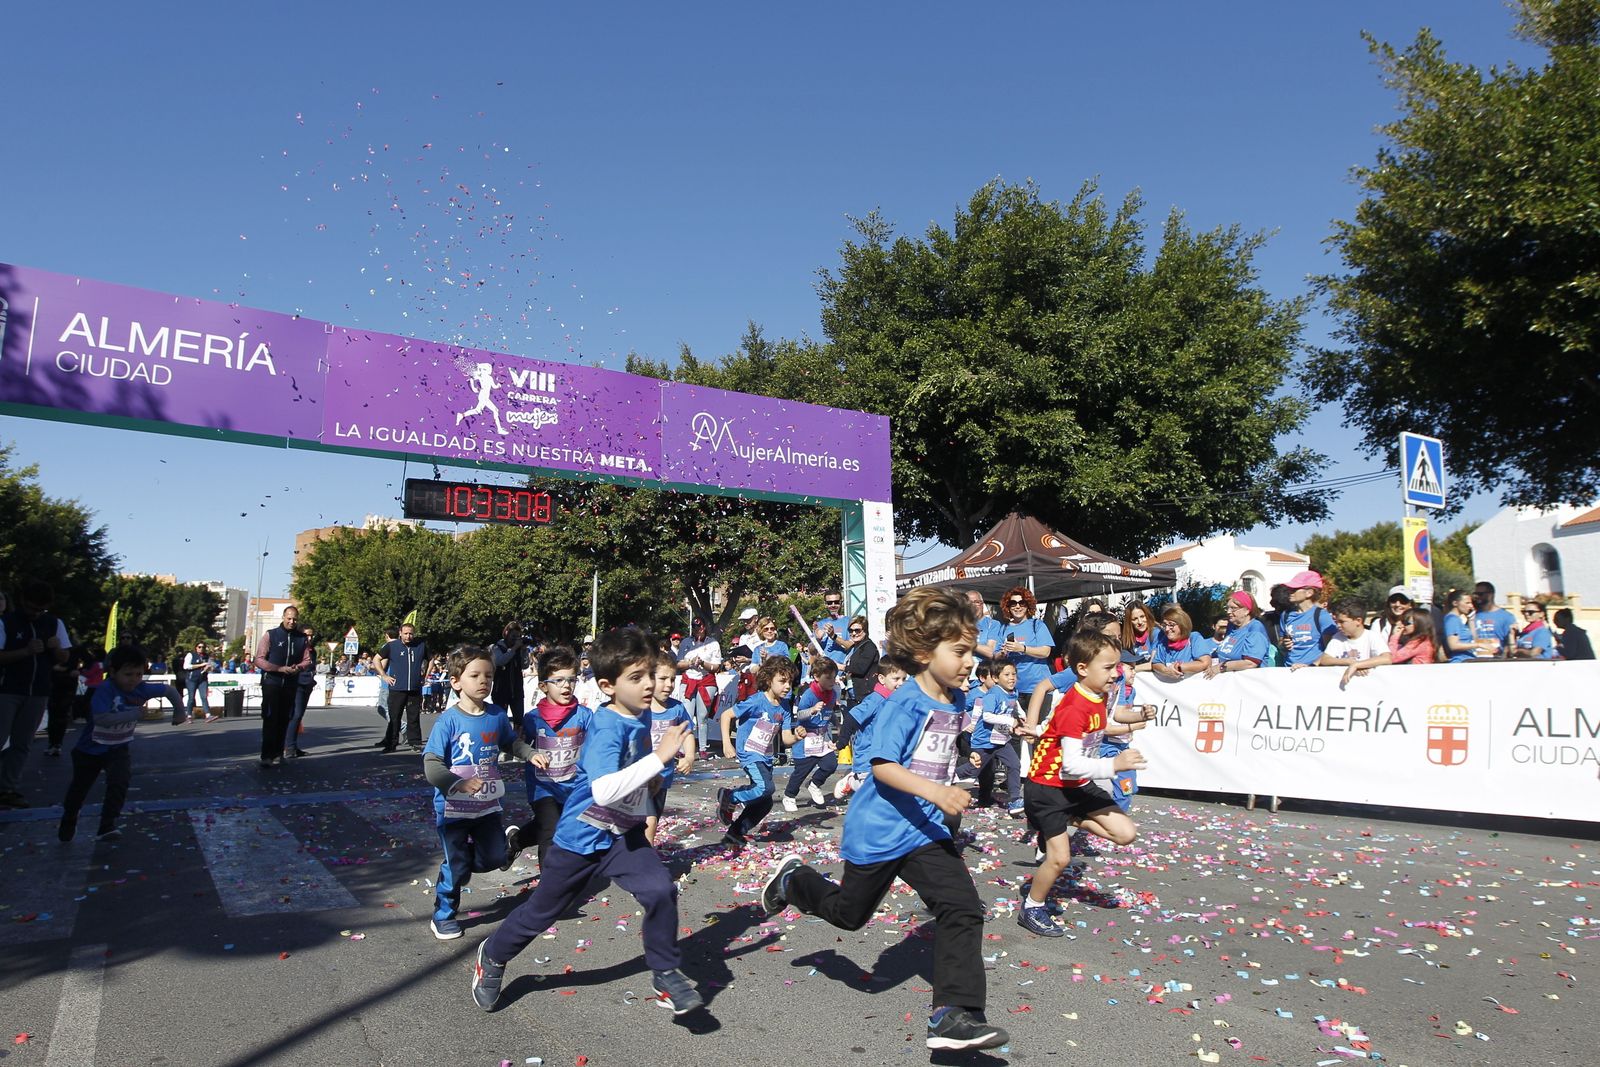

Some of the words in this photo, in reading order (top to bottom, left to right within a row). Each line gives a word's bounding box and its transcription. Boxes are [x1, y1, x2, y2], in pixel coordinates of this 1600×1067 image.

[58, 312, 277, 376] ALMERÍA
[55, 350, 173, 386] CIUDAD
[508, 366, 556, 393] VIII
[507, 391, 557, 405] CARRERA
[505, 407, 559, 430] mujer
[335, 422, 362, 440] LA
[368, 425, 477, 452] IGUALDAD
[483, 439, 507, 455] ES
[512, 443, 596, 466] NUESTRA
[600, 454, 653, 473] META.
[1252, 700, 1409, 734] ALMERÍA
[545, 747, 579, 762] 3127
[1250, 733, 1326, 753] CIUDAD
